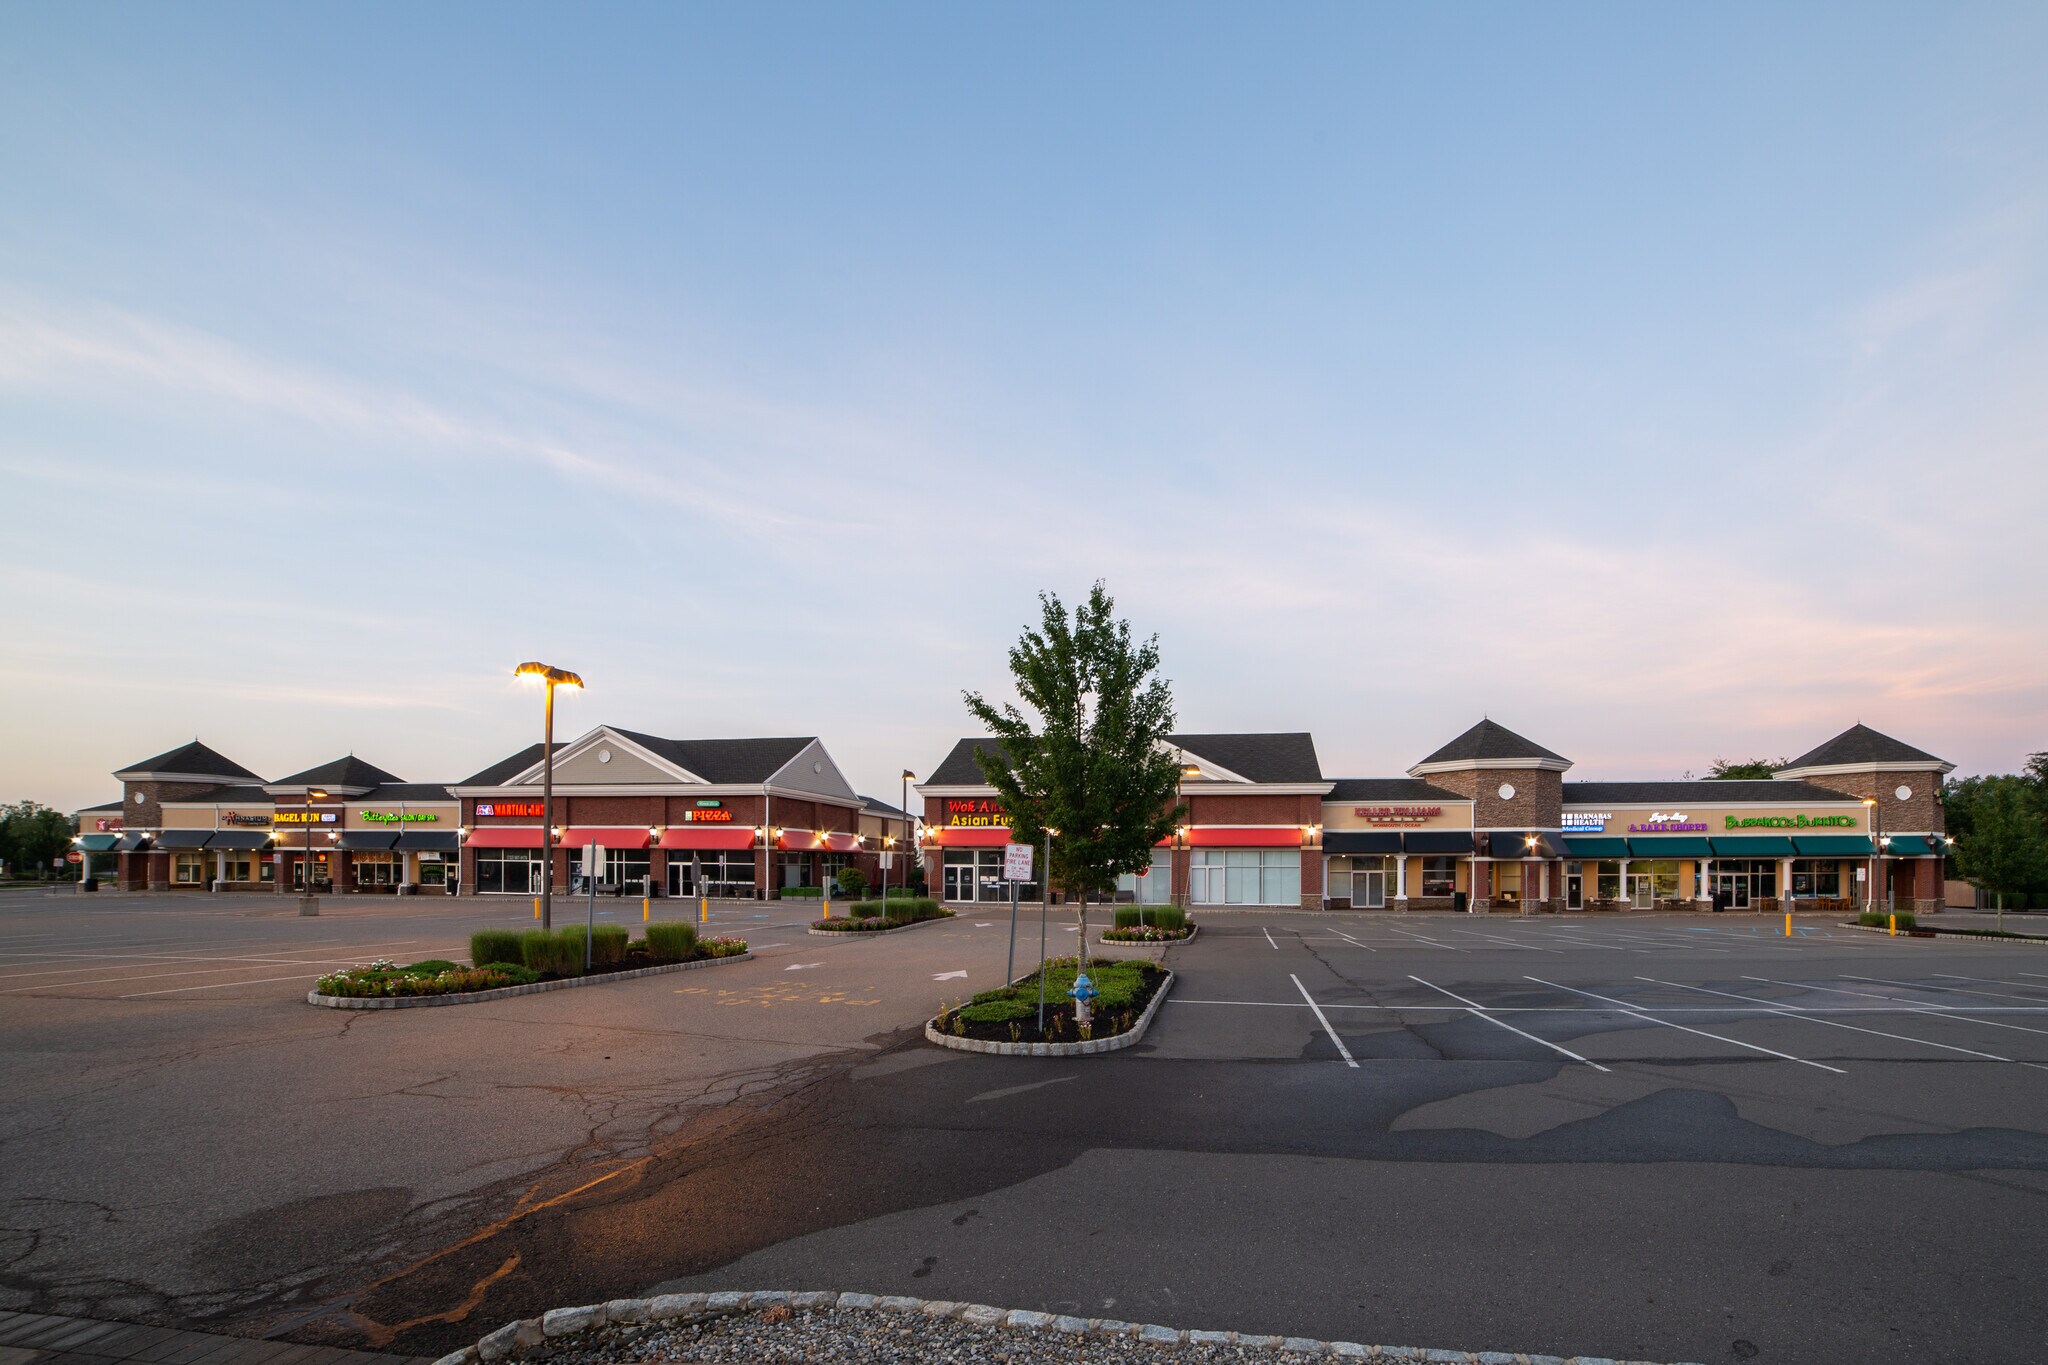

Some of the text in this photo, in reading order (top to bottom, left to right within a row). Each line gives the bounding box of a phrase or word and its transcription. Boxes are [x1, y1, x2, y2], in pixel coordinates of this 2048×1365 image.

[494, 804, 528, 816] MARTIAL
[530, 804, 545, 816] ART
[949, 801, 976, 812] Wok
[1355, 807, 1442, 816] KELLER WILLIAMS
[274, 813, 300, 822] BAGEL
[693, 811, 731, 821] PIZZA
[951, 814, 989, 826] Asian
[1640, 823, 1668, 831] BAKE
[1670, 823, 1708, 831] SHOPPE
